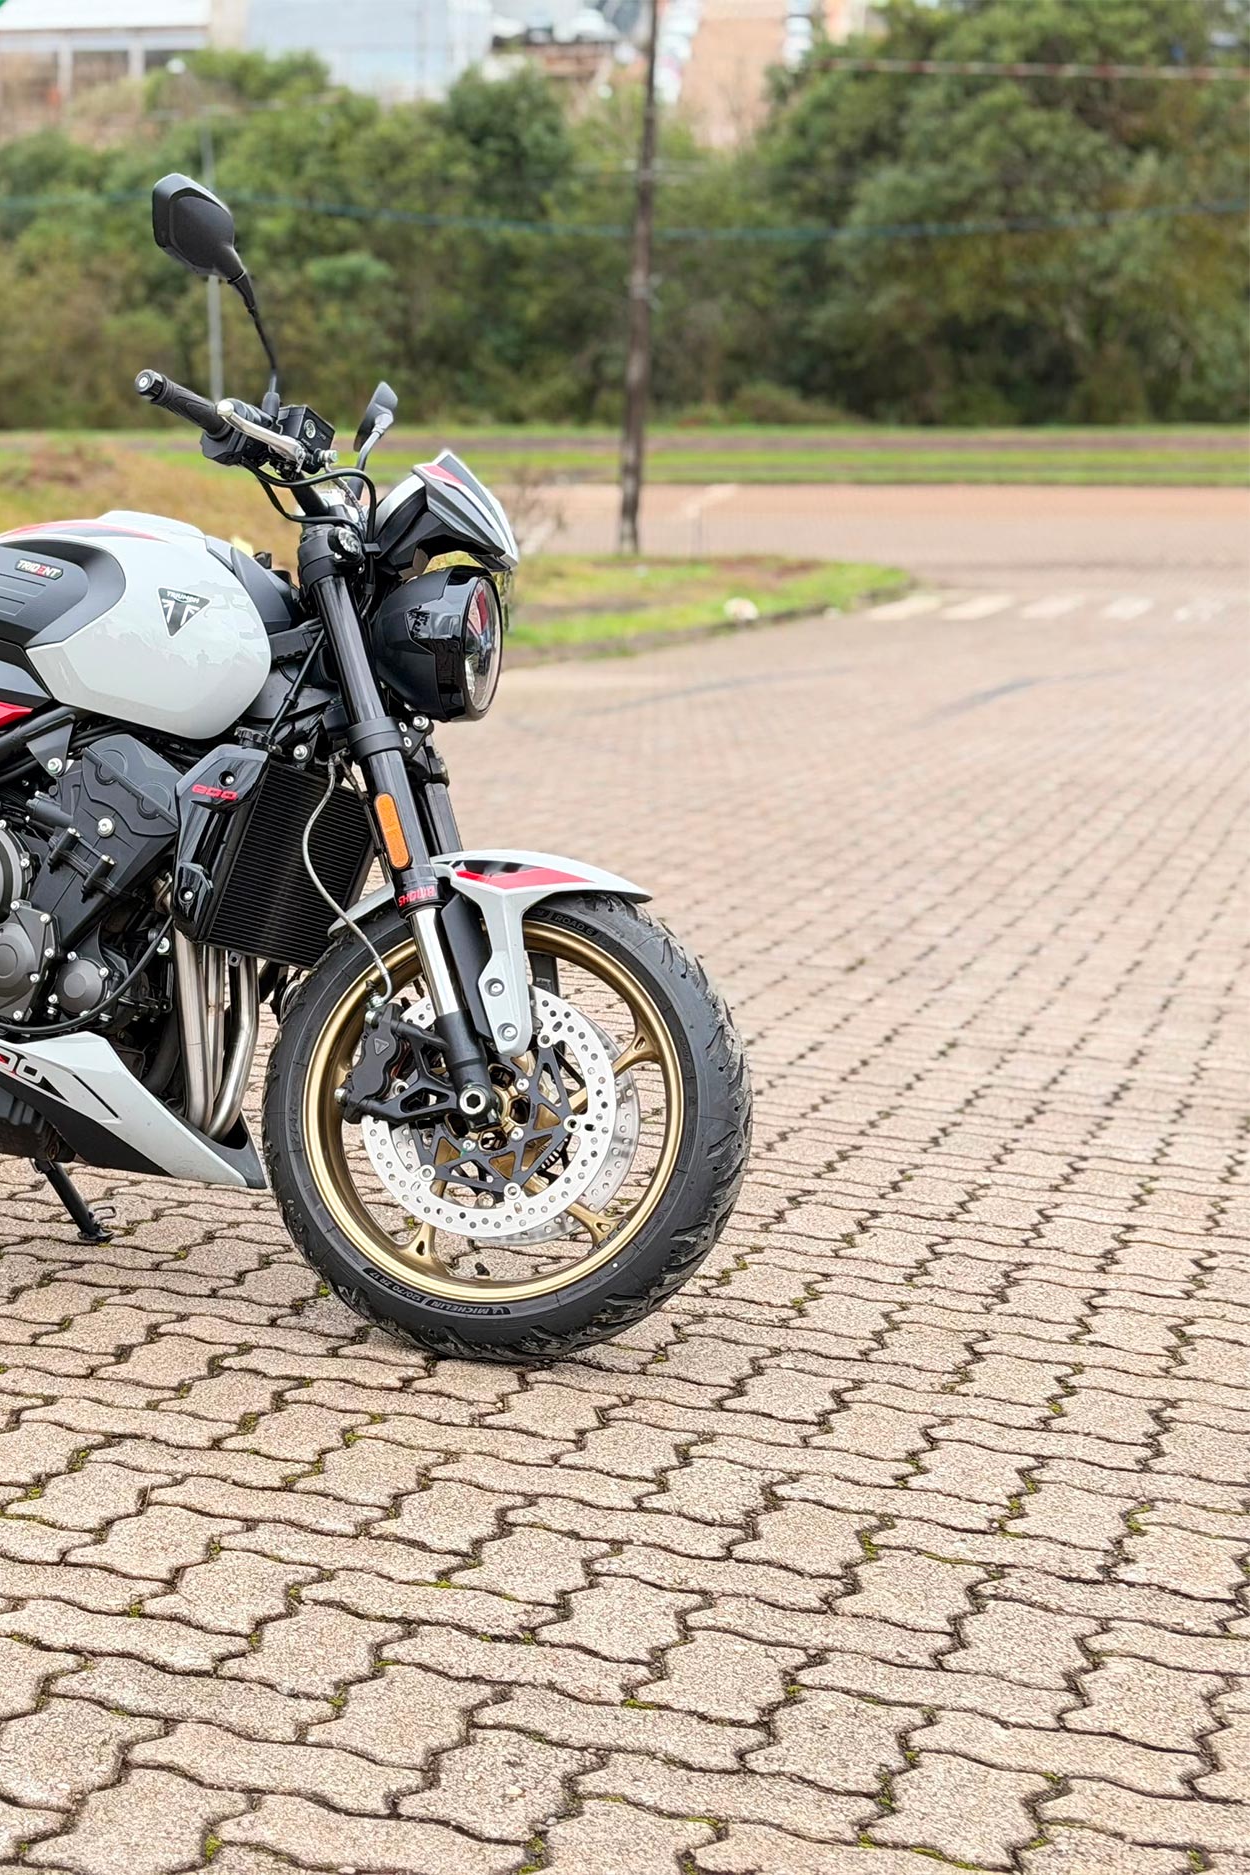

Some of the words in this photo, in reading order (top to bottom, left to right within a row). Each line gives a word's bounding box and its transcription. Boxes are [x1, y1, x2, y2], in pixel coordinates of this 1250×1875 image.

[17, 559, 62, 577] TRIDENT
[166, 590, 200, 604] TRIUMPH
[554, 914, 585, 931] ROAD
[393, 1285, 422, 1302] 120/70
[430, 1300, 490, 1315] MICHELIN
